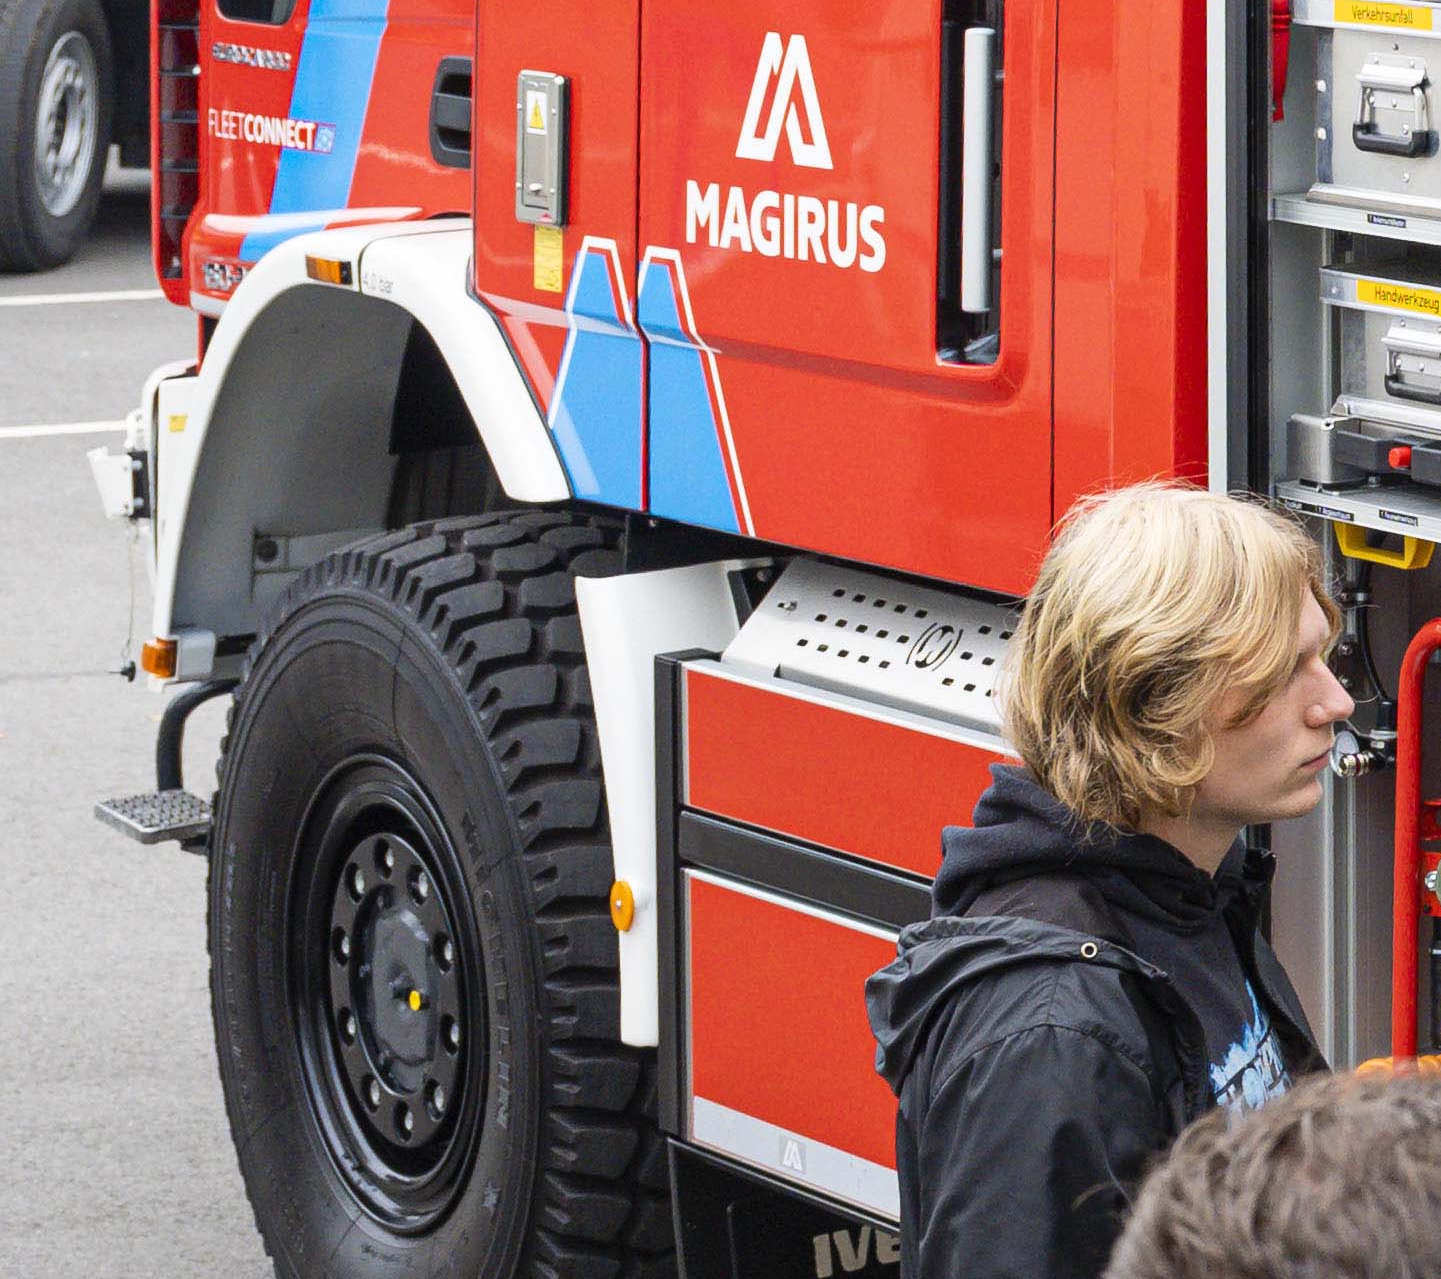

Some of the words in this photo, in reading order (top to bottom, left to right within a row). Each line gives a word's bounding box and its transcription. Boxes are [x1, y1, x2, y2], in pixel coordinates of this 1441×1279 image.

[1352, 5, 1414, 24] Verkehrsunfall
[208, 108, 316, 150] FLEETCONNECT
[686, 180, 885, 272] MAGIRUS
[1374, 285, 1441, 313] Handwerkzeug
[814, 1227, 900, 1279] IVE
